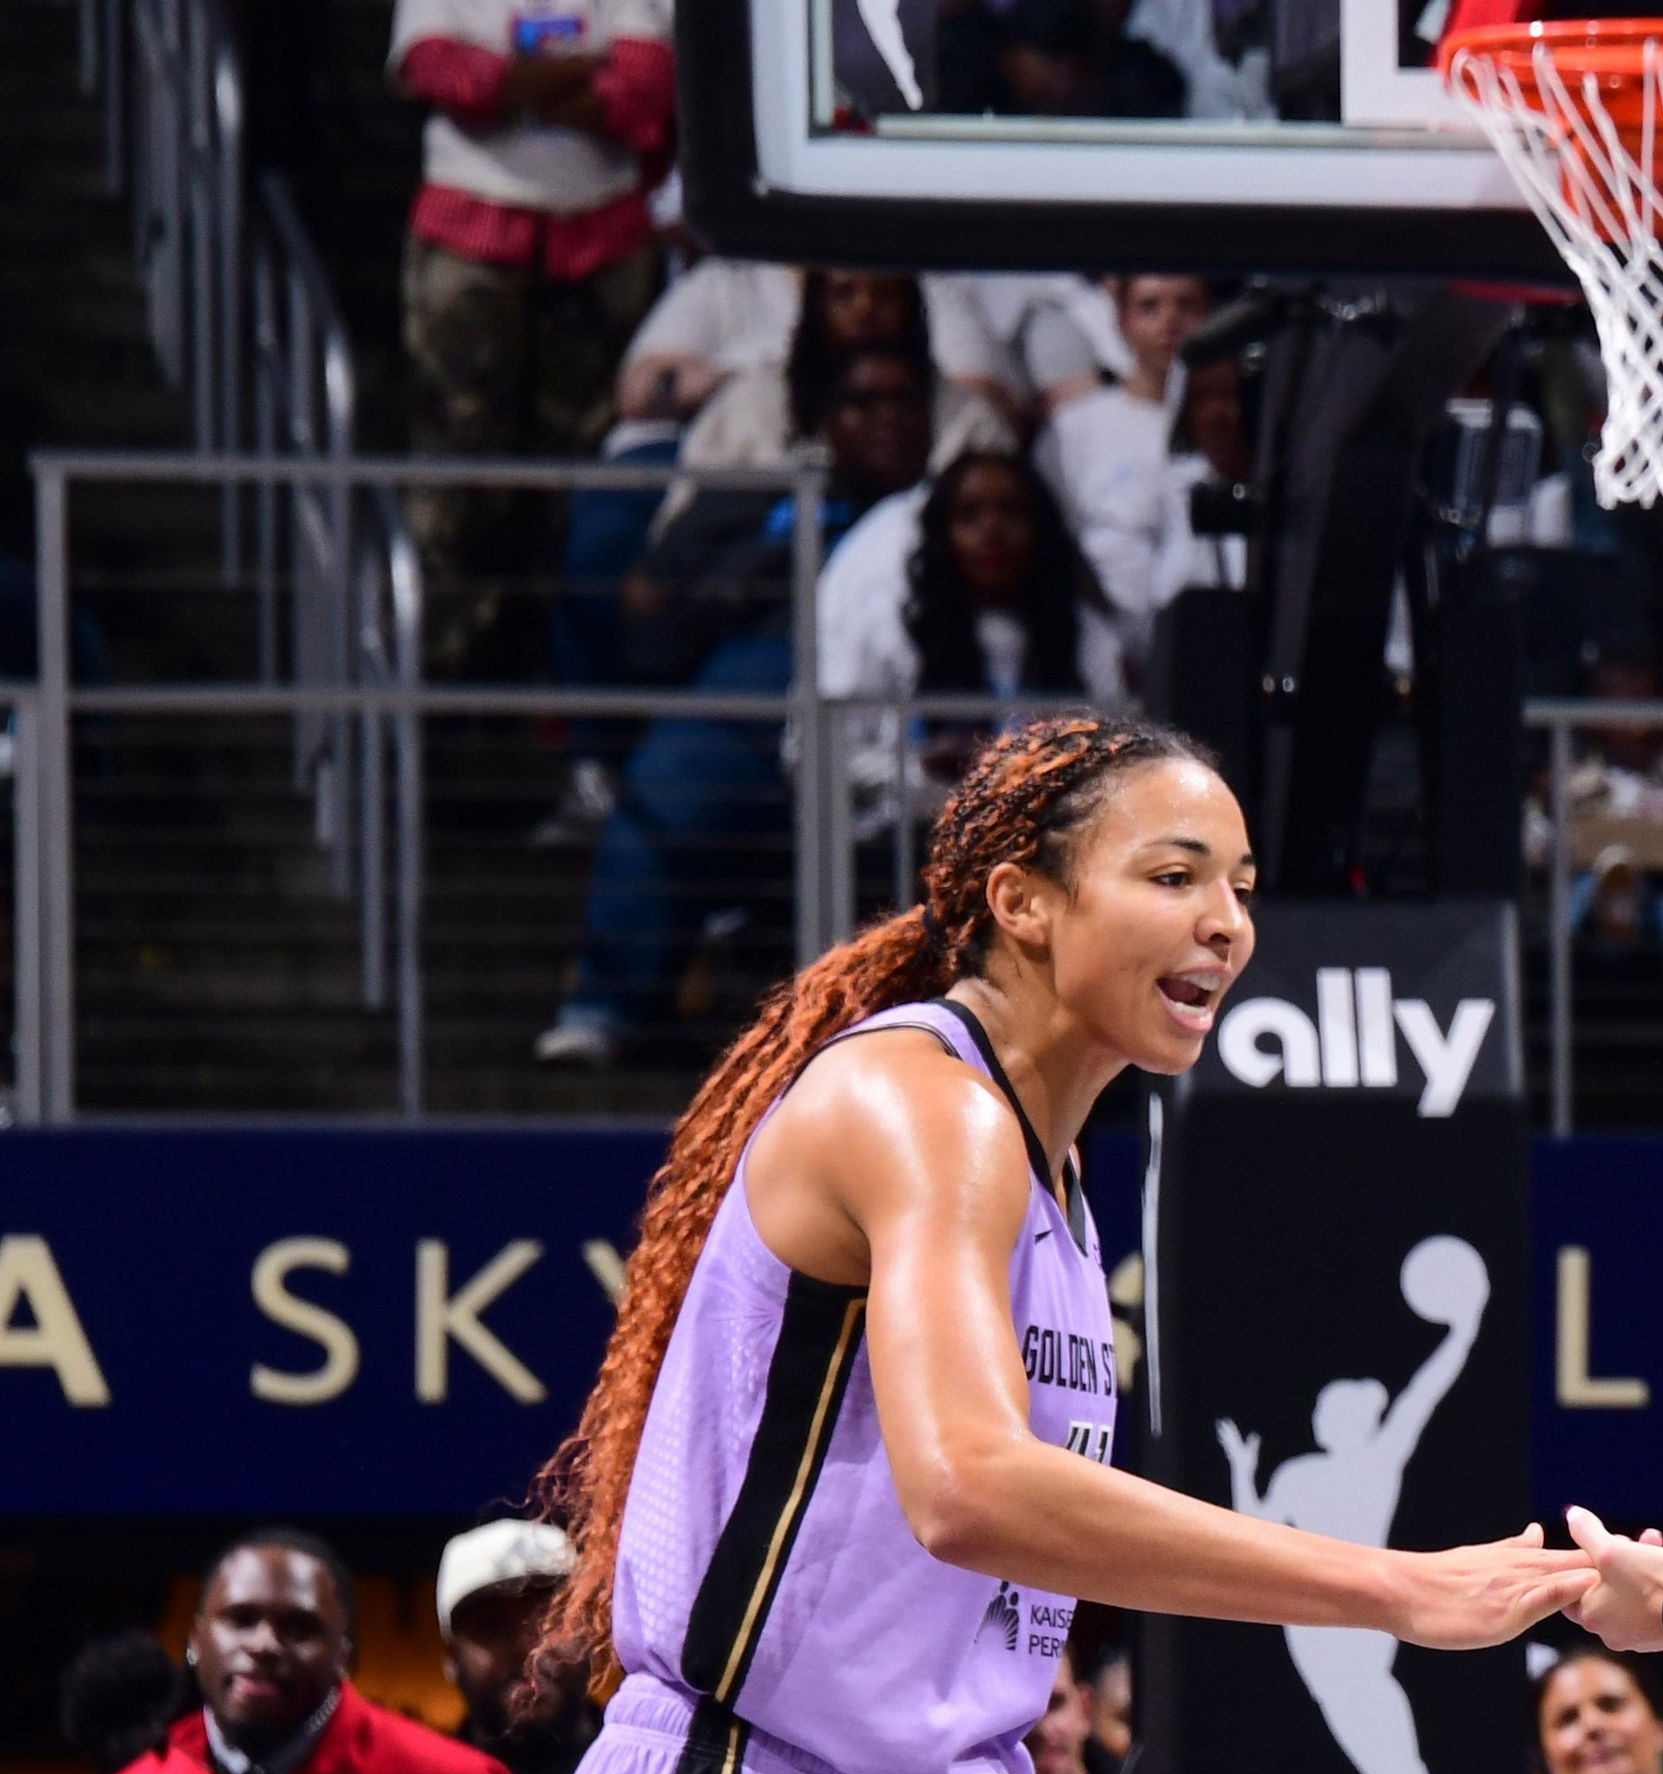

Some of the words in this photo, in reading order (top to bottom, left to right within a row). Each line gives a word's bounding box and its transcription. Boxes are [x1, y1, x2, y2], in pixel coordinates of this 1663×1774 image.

[1217, 966, 1496, 1118] ally
[1021, 1324, 1098, 1395] GOLDEN
[1030, 1604, 1074, 1631] KAISE
[1029, 1634, 1064, 1658] PER
